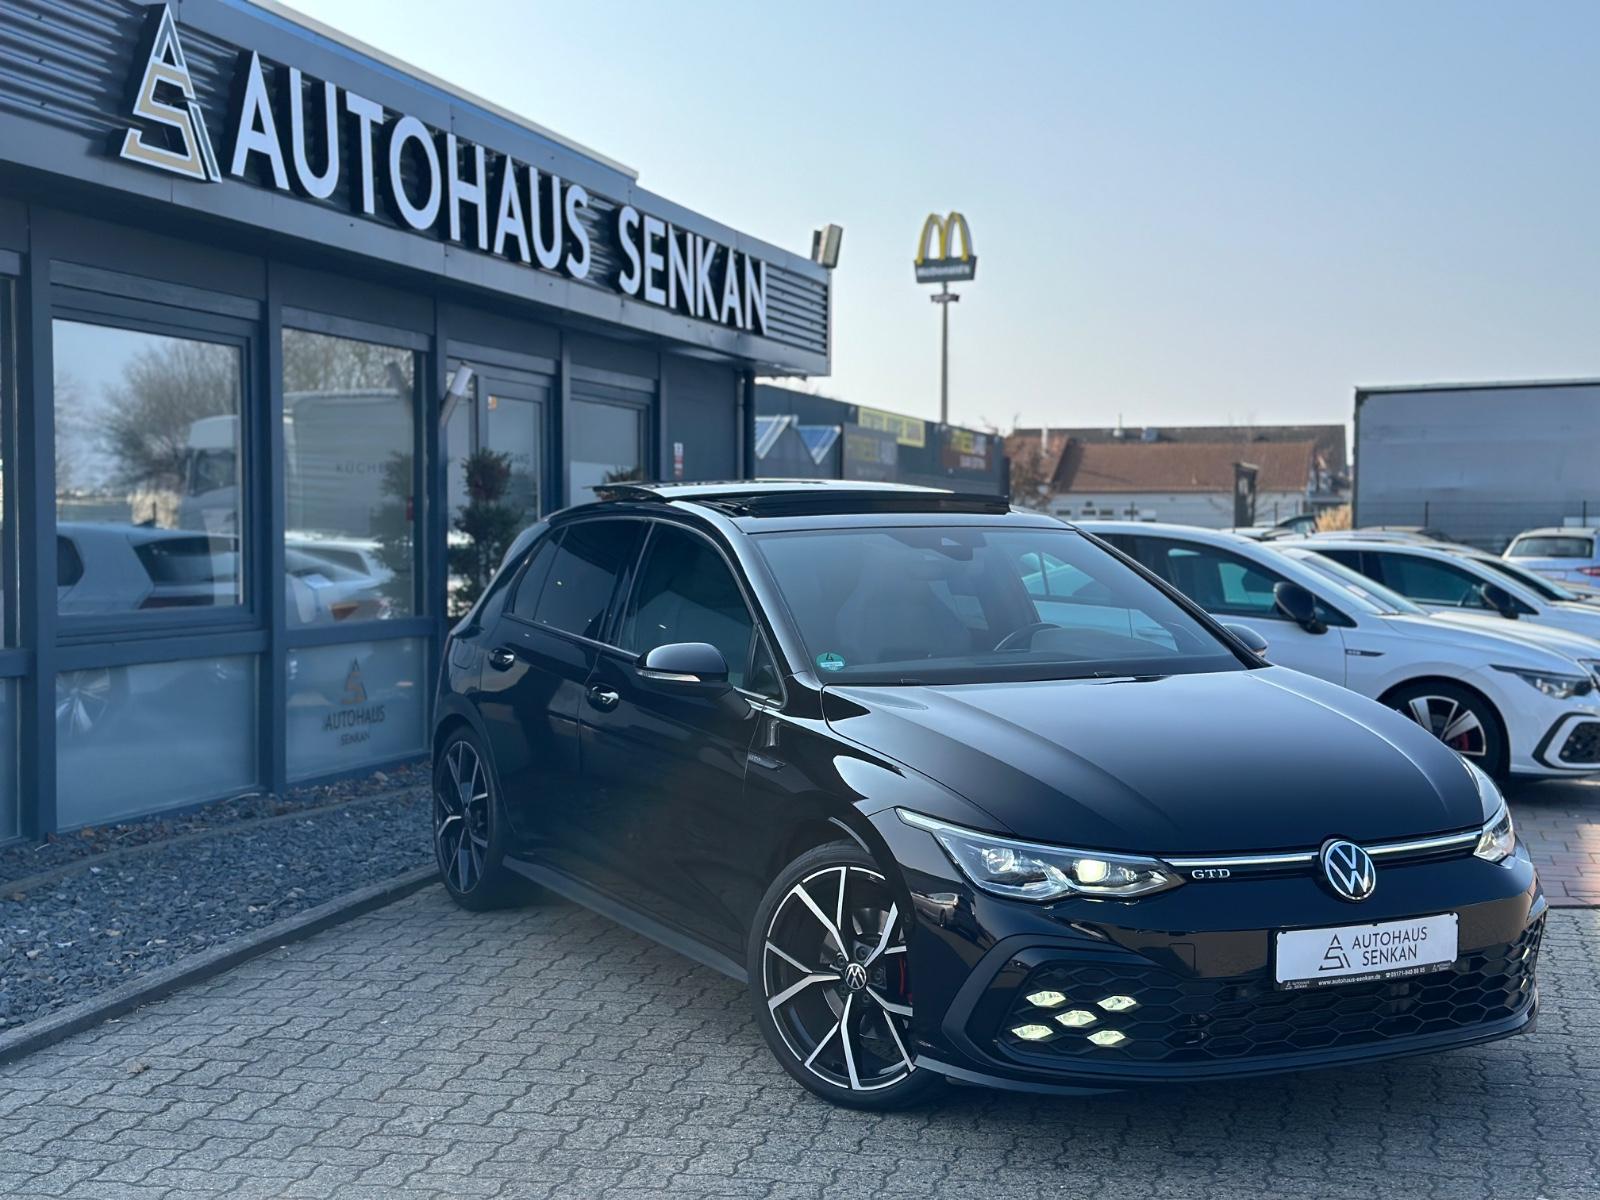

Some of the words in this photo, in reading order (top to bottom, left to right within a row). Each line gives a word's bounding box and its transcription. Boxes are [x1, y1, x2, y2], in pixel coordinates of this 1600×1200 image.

[231, 50, 591, 280] AUTOHAUS
[618, 205, 768, 335] SENKAN
[323, 704, 386, 731] AUTOHAUS
[1191, 868, 1231, 880] GTD
[1352, 926, 1428, 950] AUTOHAUS
[1362, 943, 1418, 967] SENKAN
